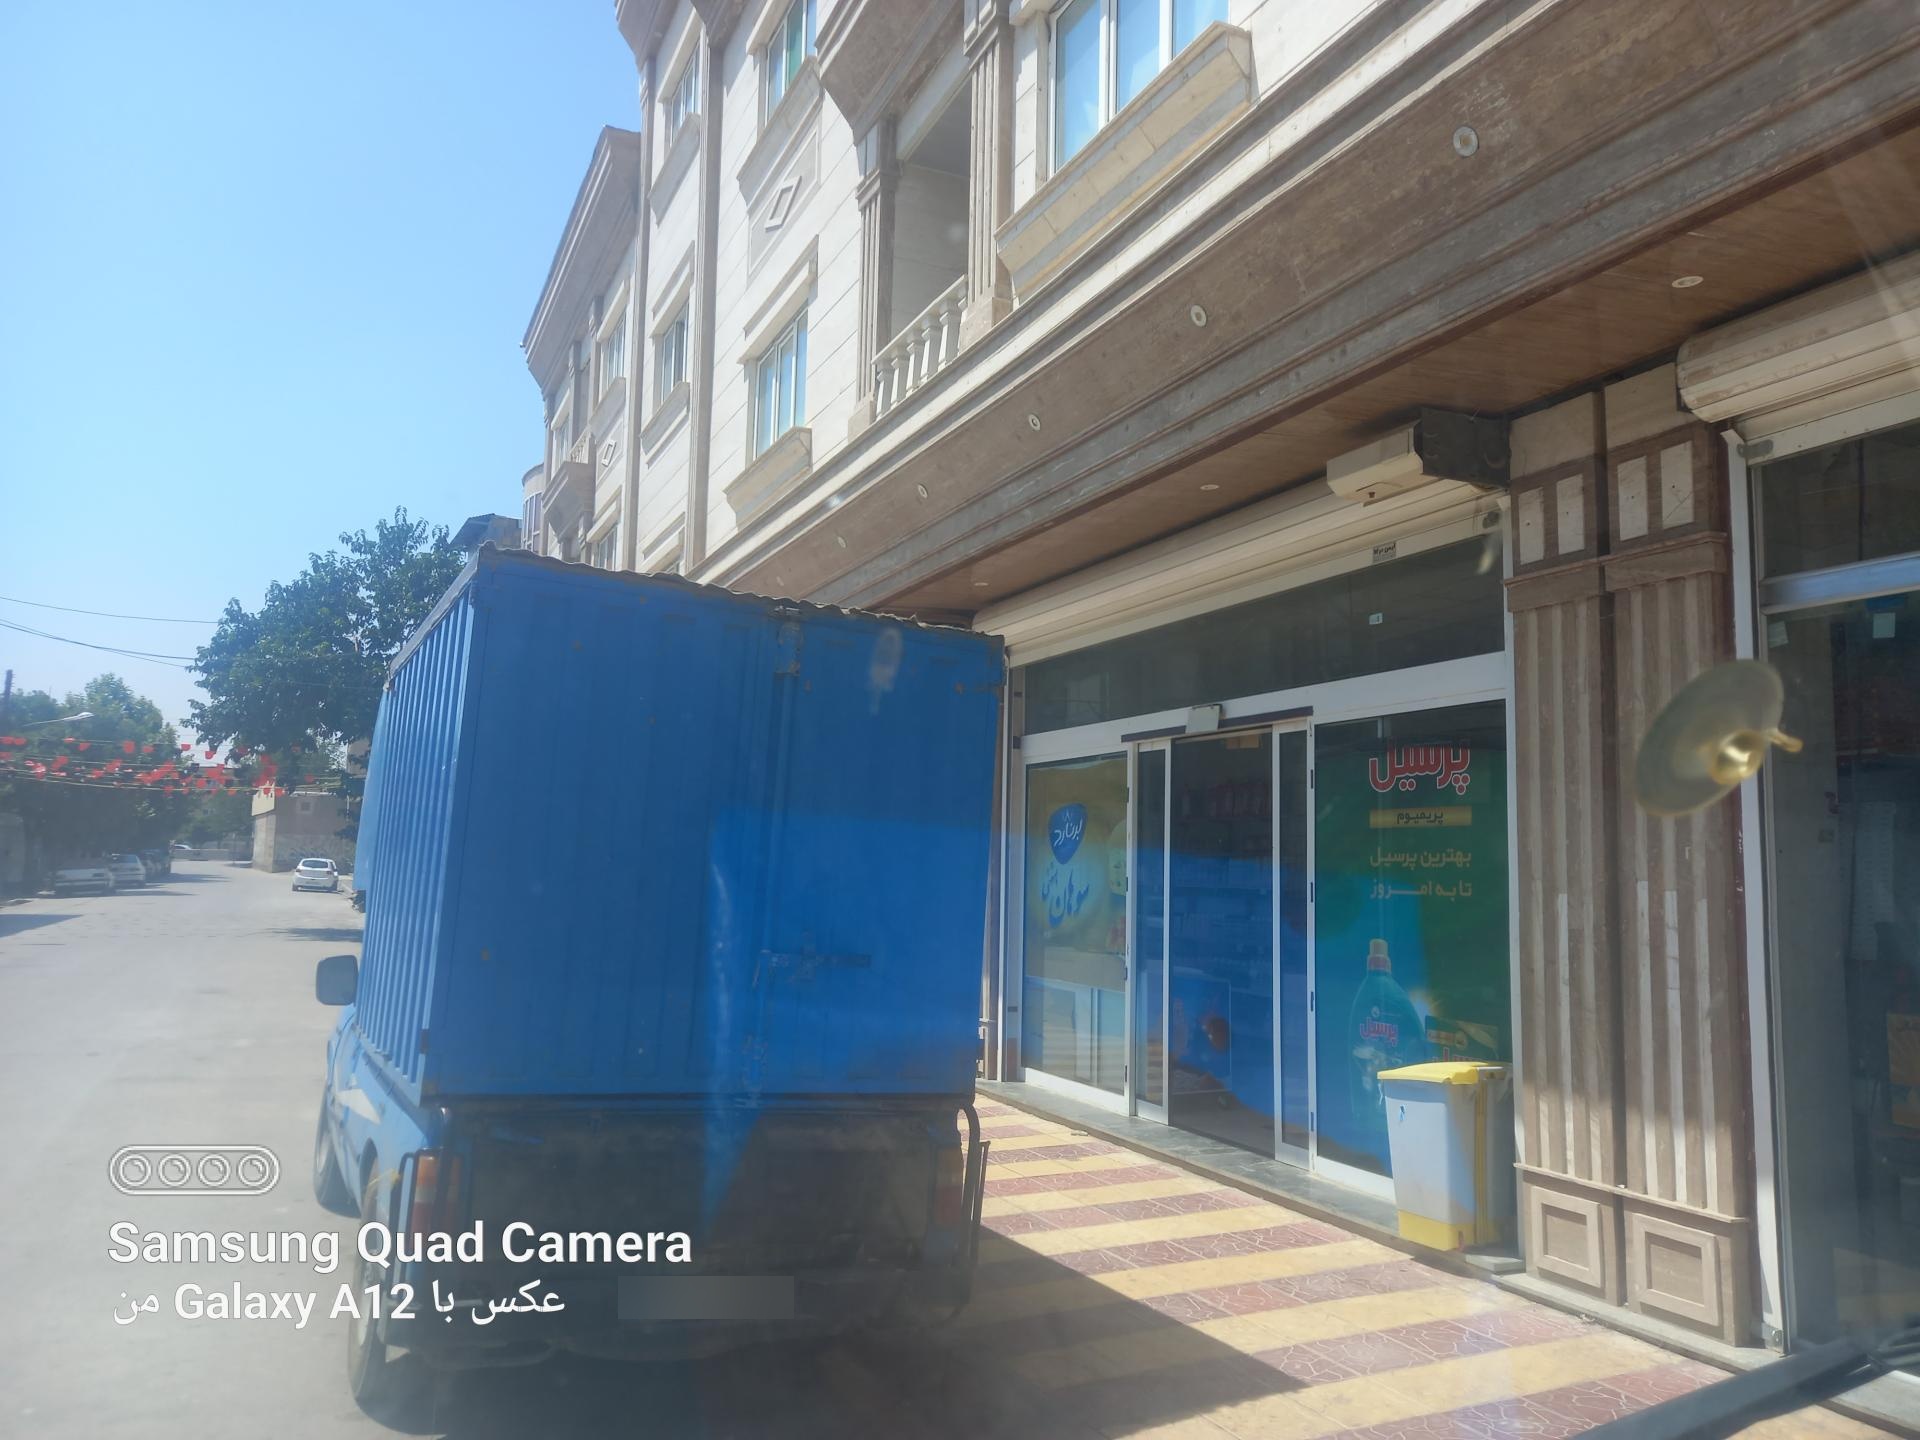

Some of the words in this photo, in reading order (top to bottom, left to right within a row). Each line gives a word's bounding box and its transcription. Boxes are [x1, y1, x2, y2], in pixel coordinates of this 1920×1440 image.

[1369, 738, 1471, 796] پرسیل
[1397, 809, 1444, 825] پریمیوم
[1370, 847, 1418, 871] پرسیل
[1420, 848, 1472, 868] بهترین
